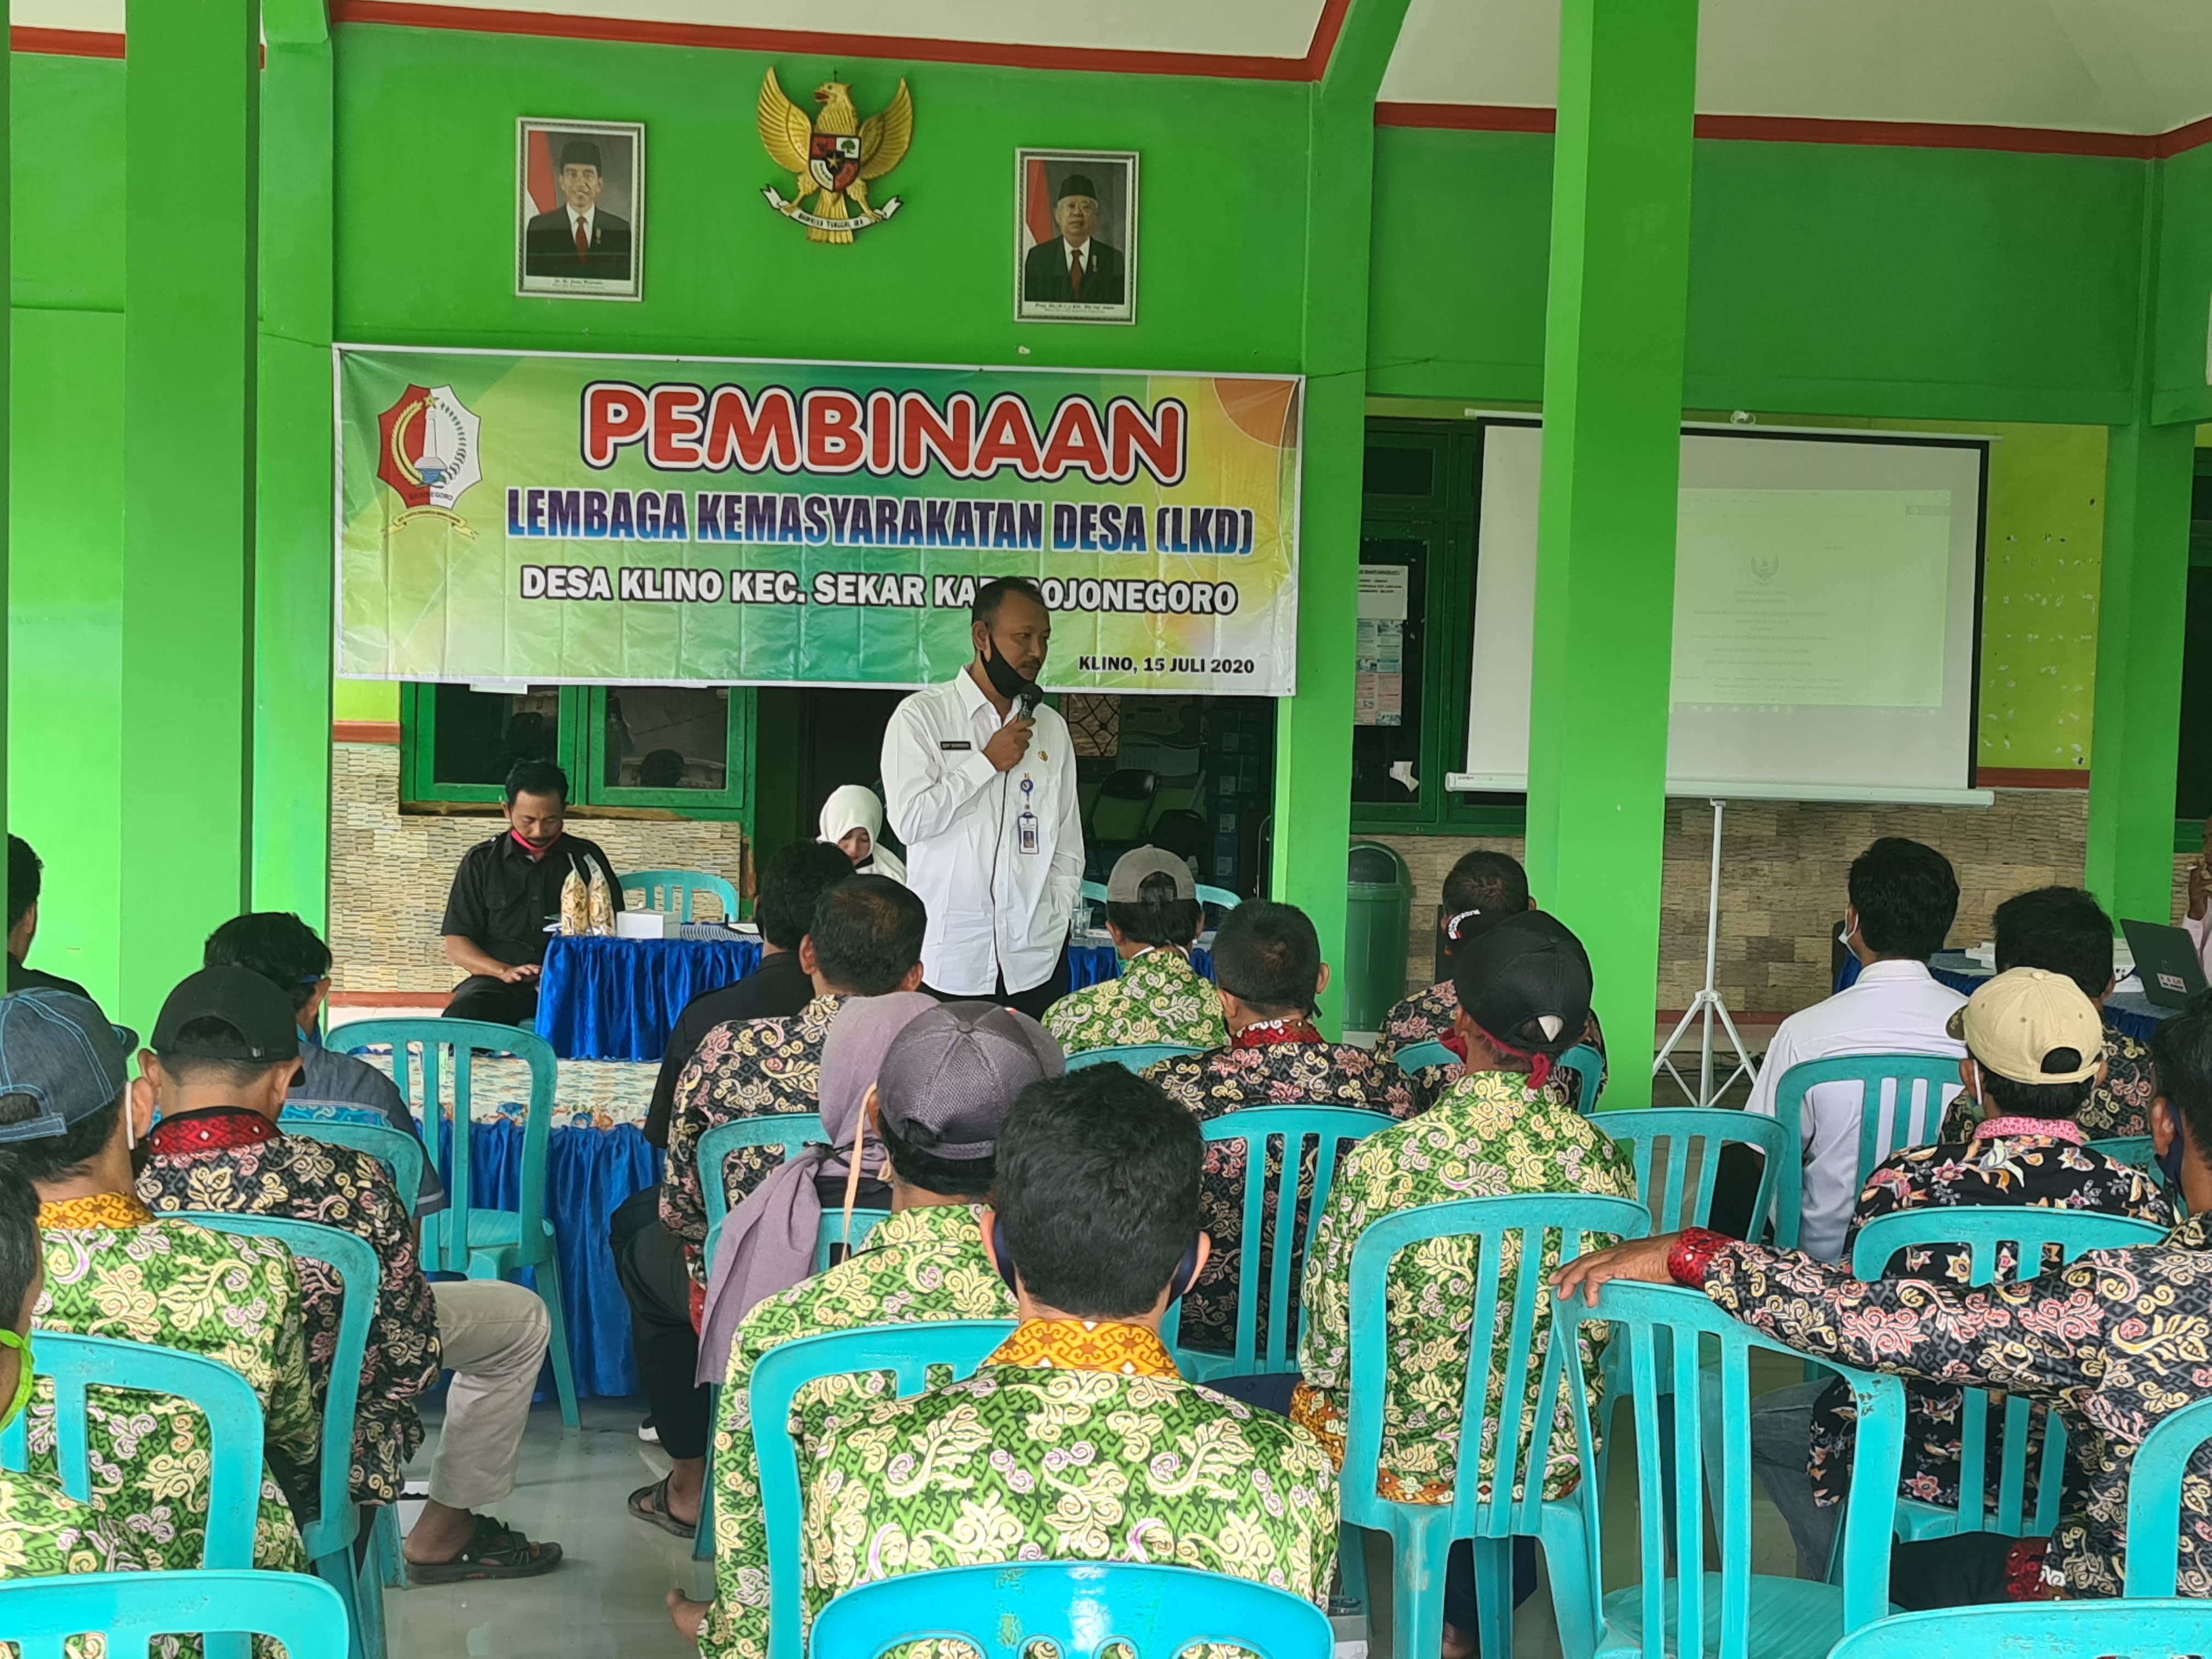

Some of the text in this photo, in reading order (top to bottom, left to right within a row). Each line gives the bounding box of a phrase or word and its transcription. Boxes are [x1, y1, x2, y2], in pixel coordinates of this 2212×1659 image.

[582, 381, 1187, 487] PEMBINAAN
[507, 488, 1253, 556] LEMBAGA KEMASYARAKATAN DESA (LKD)
[521, 565, 613, 600] DESA
[619, 567, 723, 602] KLINO
[731, 569, 806, 604] KEC.
[814, 572, 927, 607] SEKAR
[1018, 576, 1238, 616] OJONEGORO
[1079, 656, 1255, 675] KLINO, 15 JULI 2020
